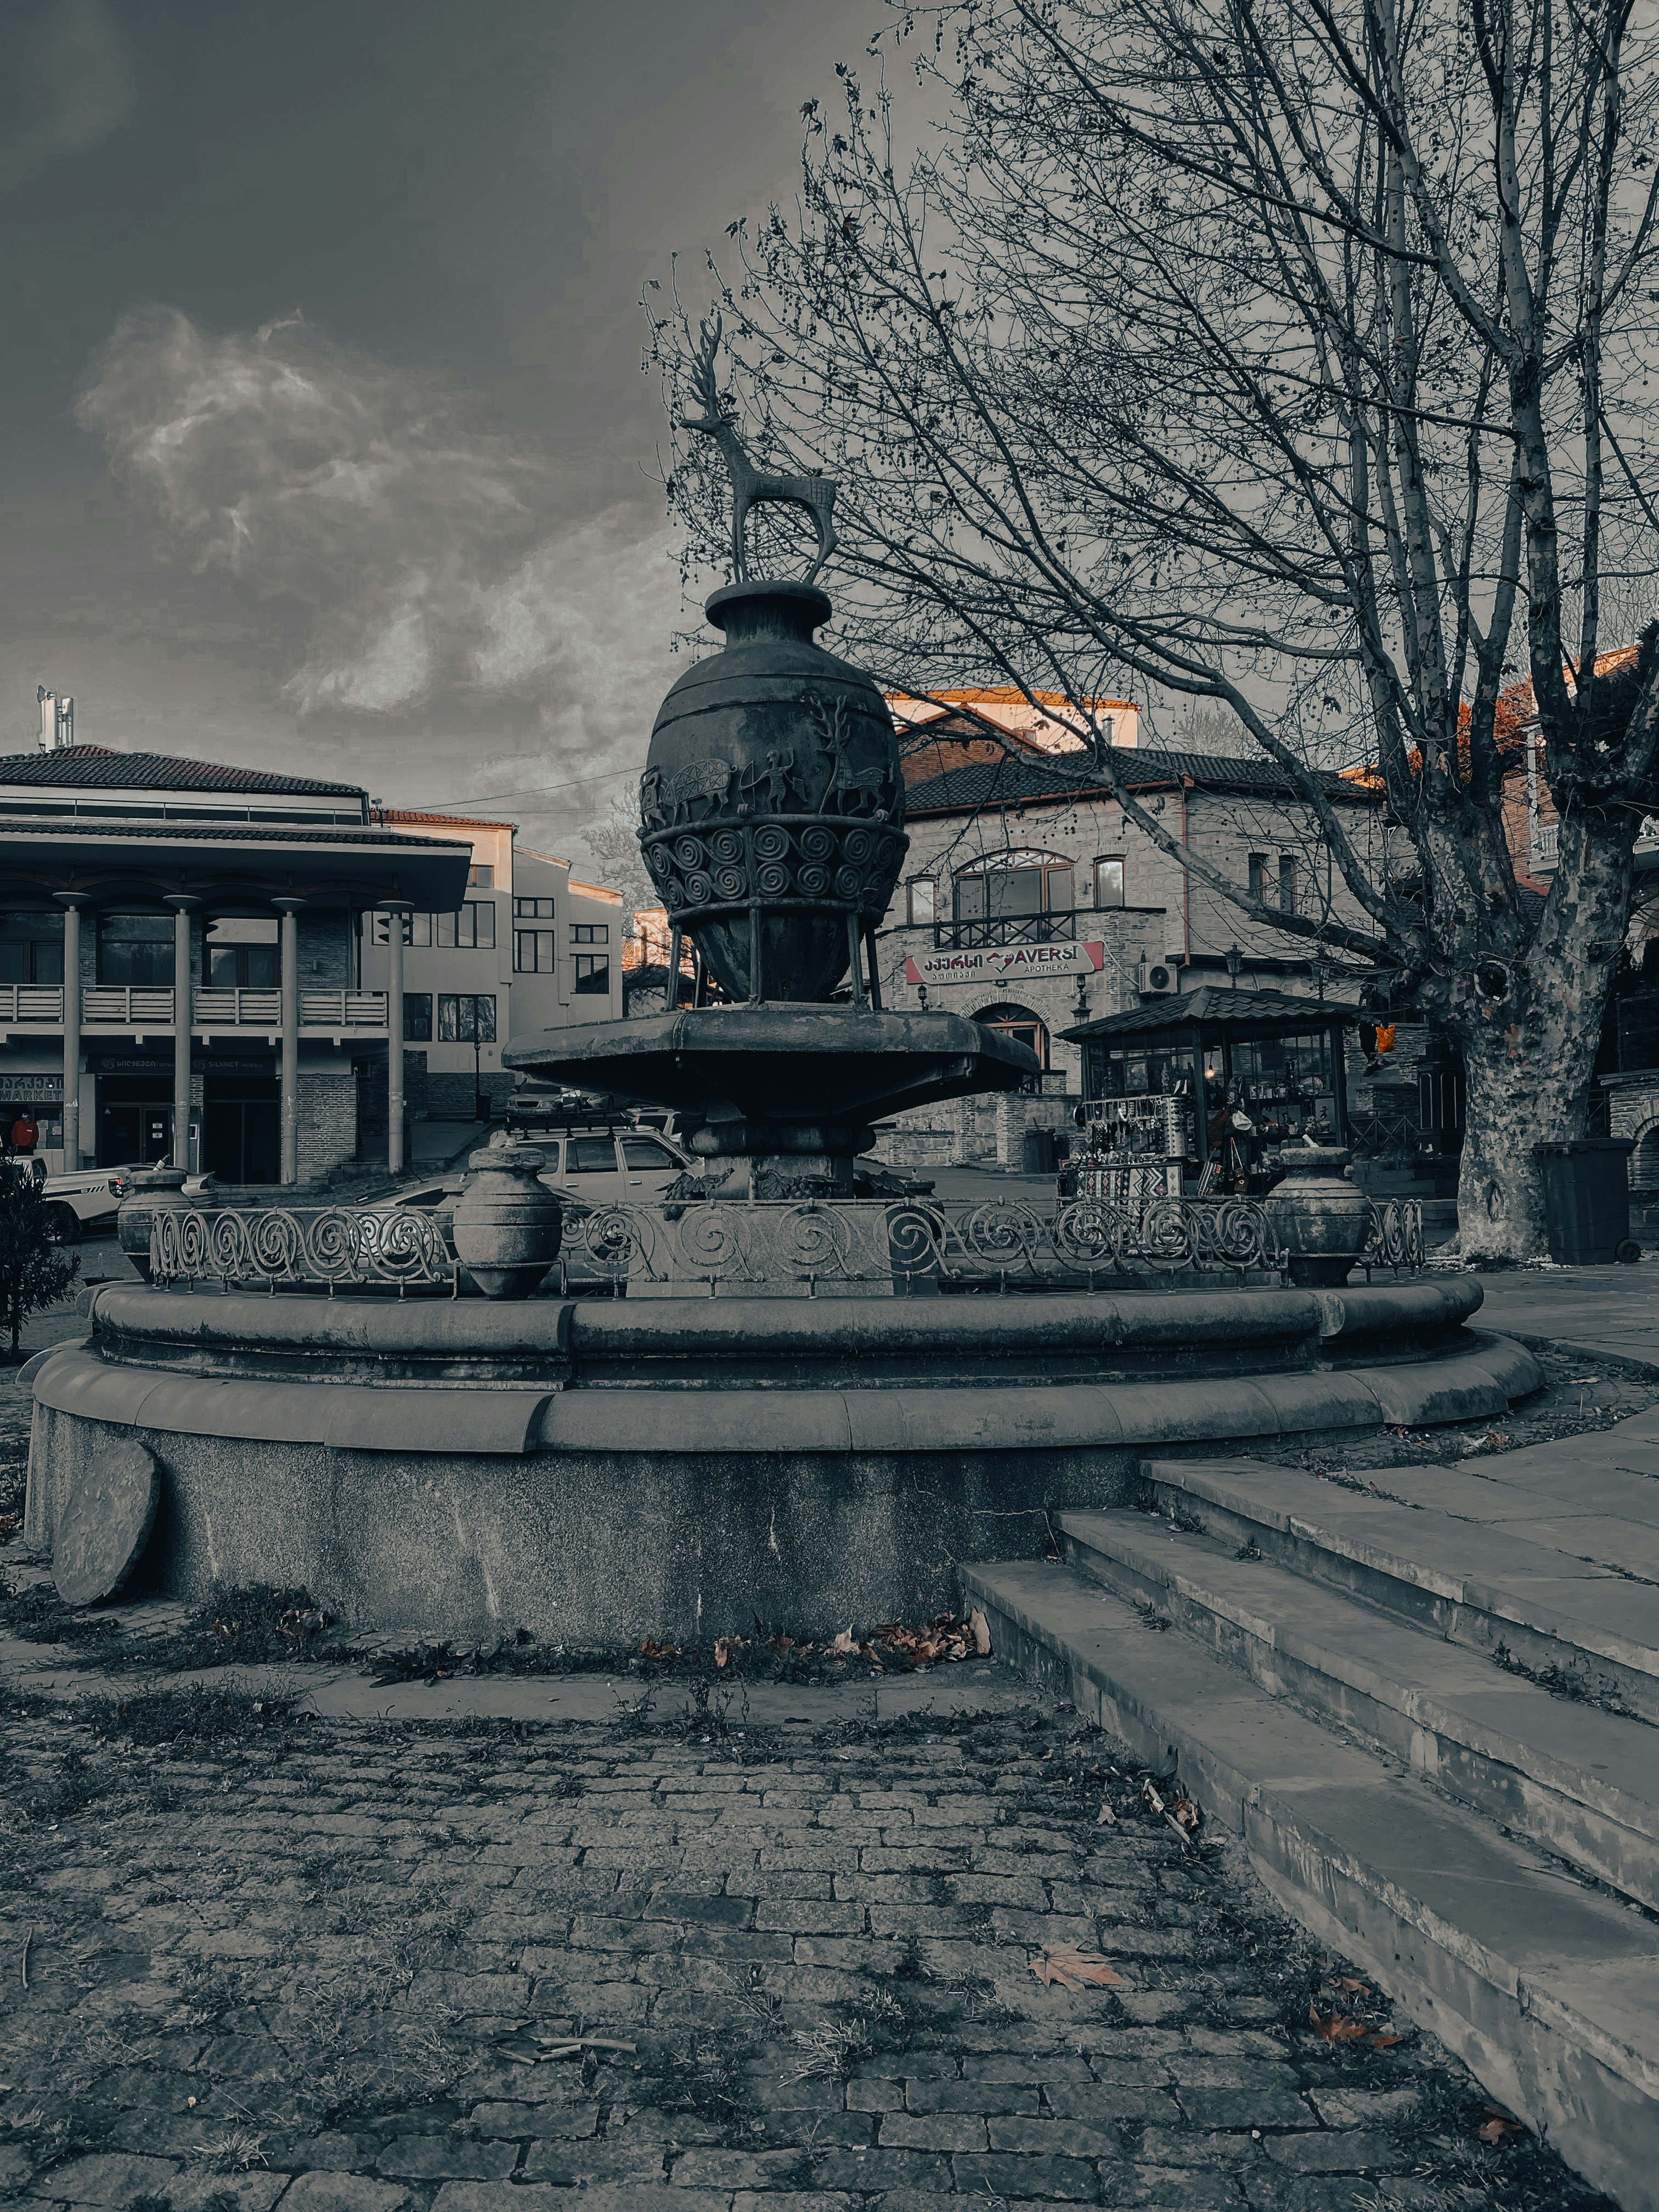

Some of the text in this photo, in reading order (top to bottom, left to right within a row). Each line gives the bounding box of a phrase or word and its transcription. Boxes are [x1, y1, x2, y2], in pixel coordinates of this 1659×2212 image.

[1014, 945, 1078, 964] AVERSI
[1024, 963, 1069, 973] APOTHEKA
[933, 971, 975, 980] აფთიაქი
[0, 1090, 61, 1101] MARKET
